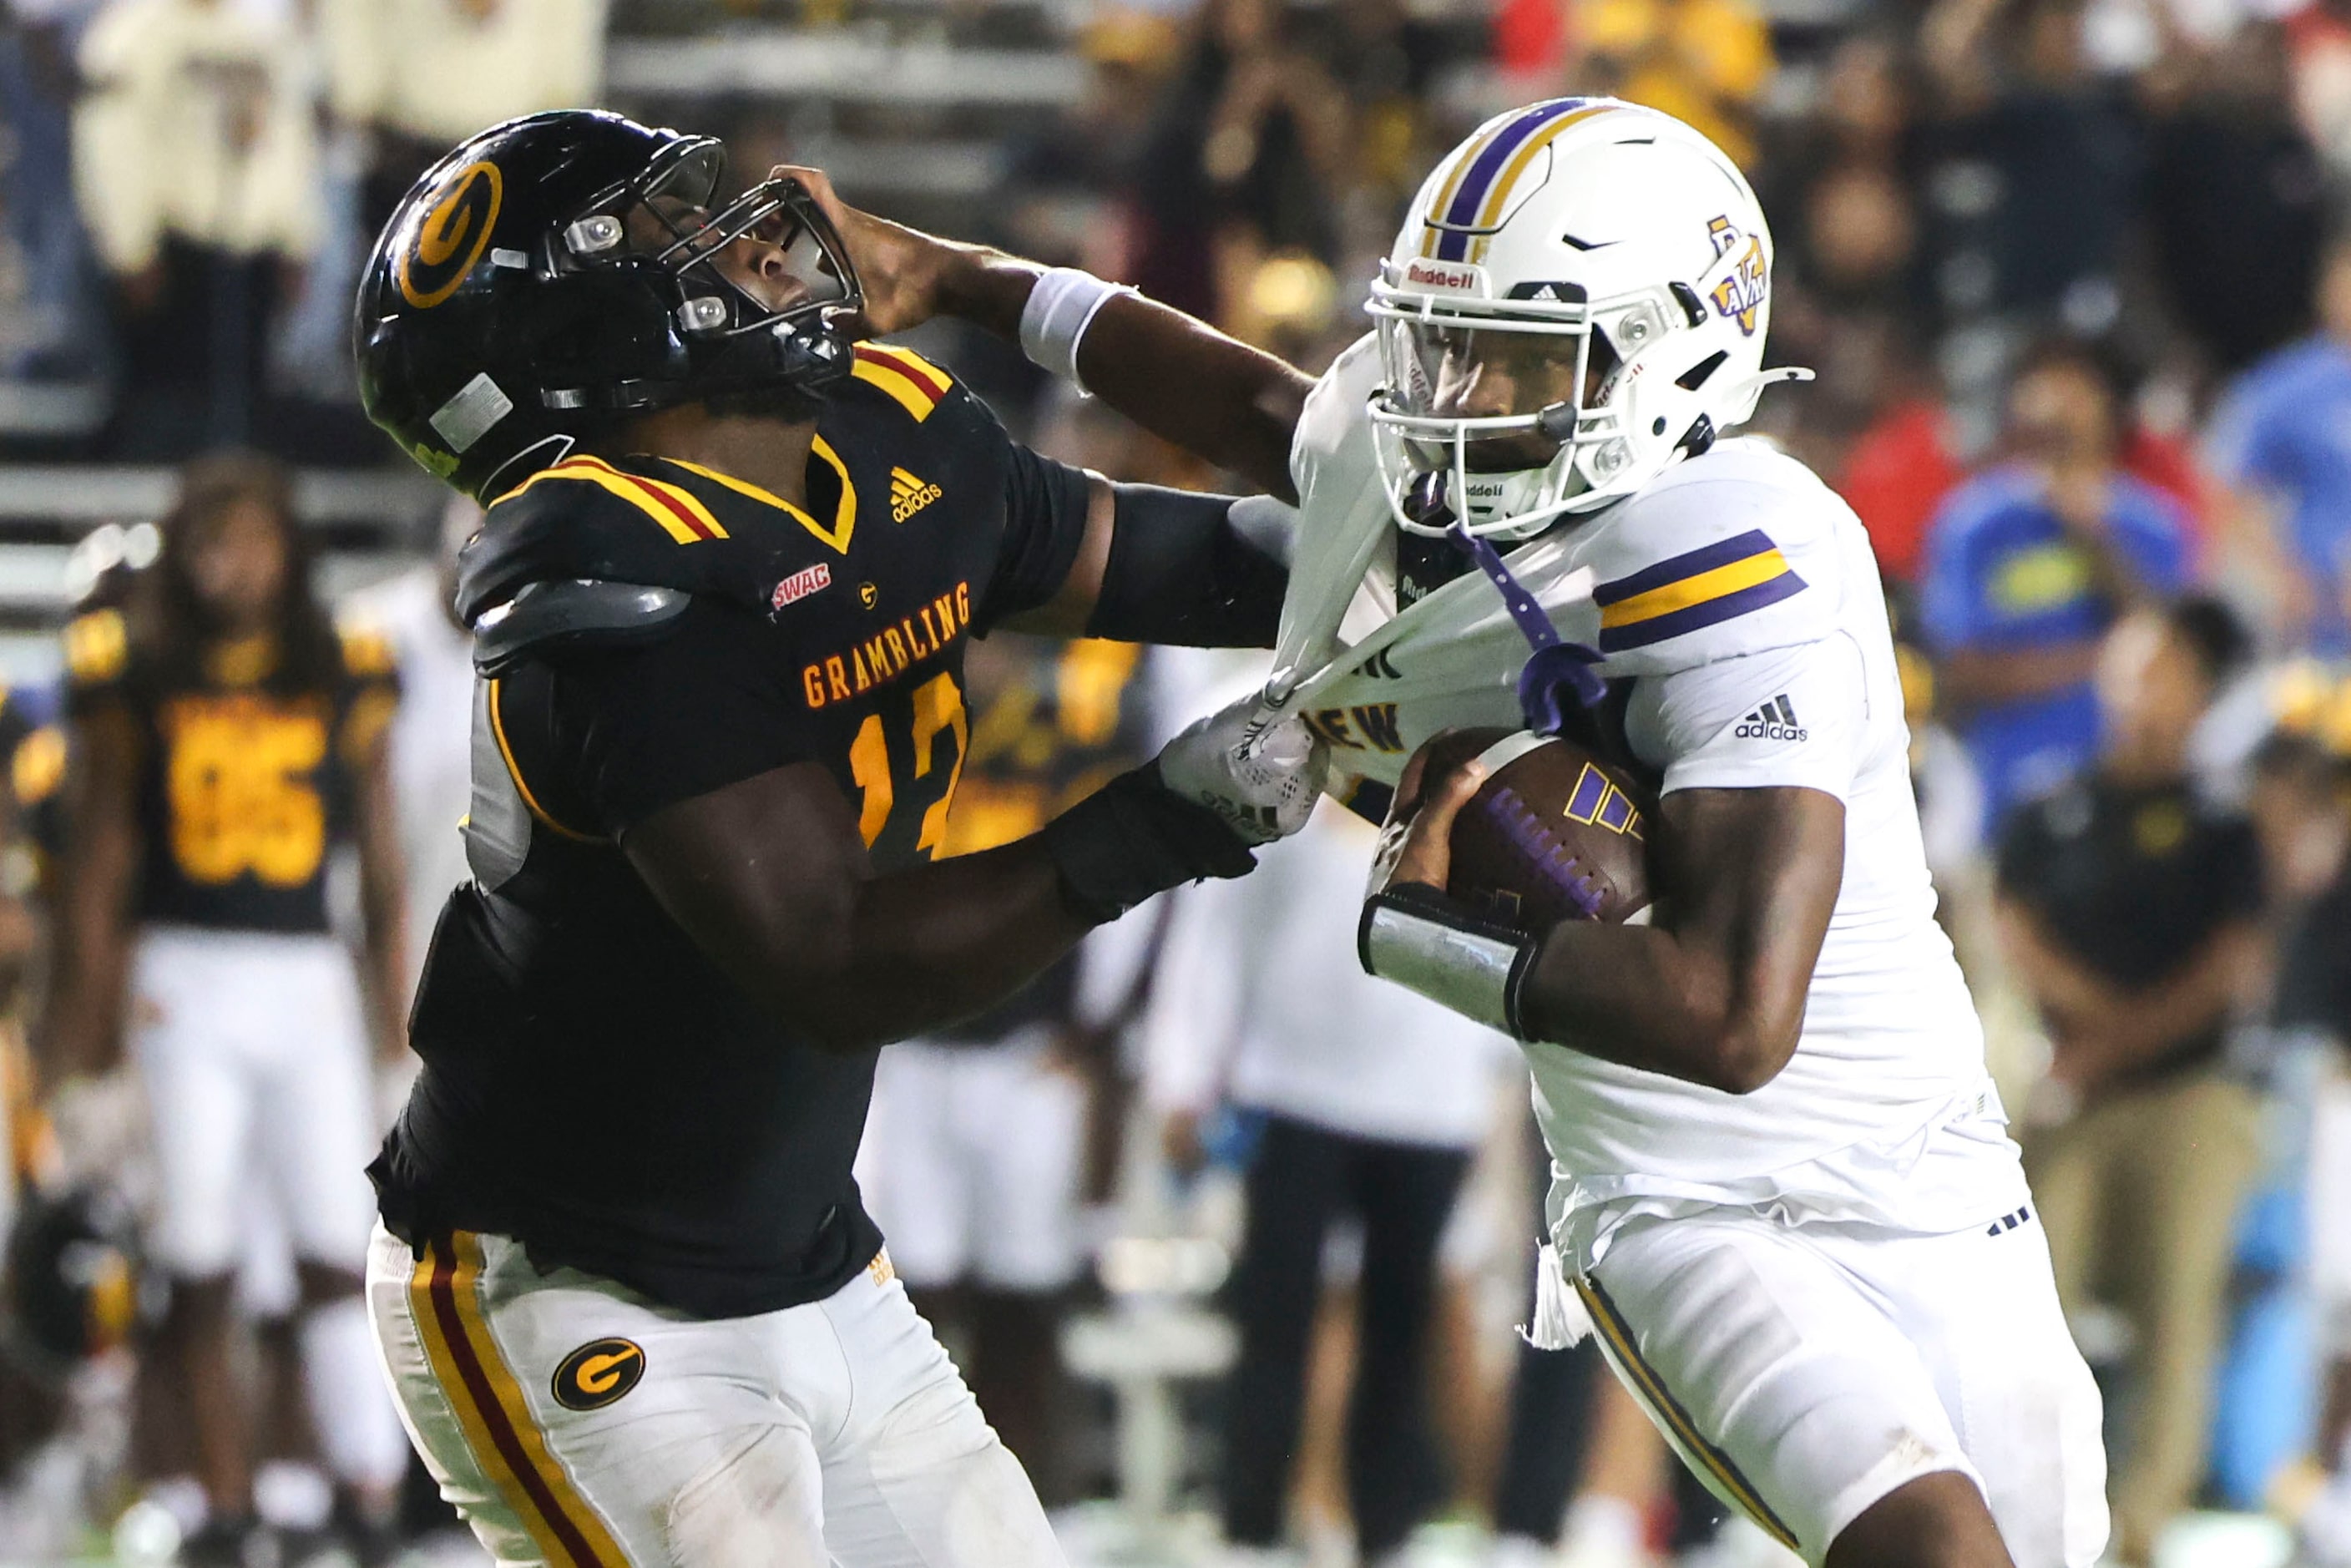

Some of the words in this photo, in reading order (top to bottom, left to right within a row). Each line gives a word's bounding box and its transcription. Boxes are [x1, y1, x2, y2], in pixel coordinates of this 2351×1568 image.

[892, 483, 943, 524] adidas
[775, 564, 830, 607] SWAC
[802, 579, 971, 709] GRAMBLING
[1734, 720, 1808, 742] adidas
